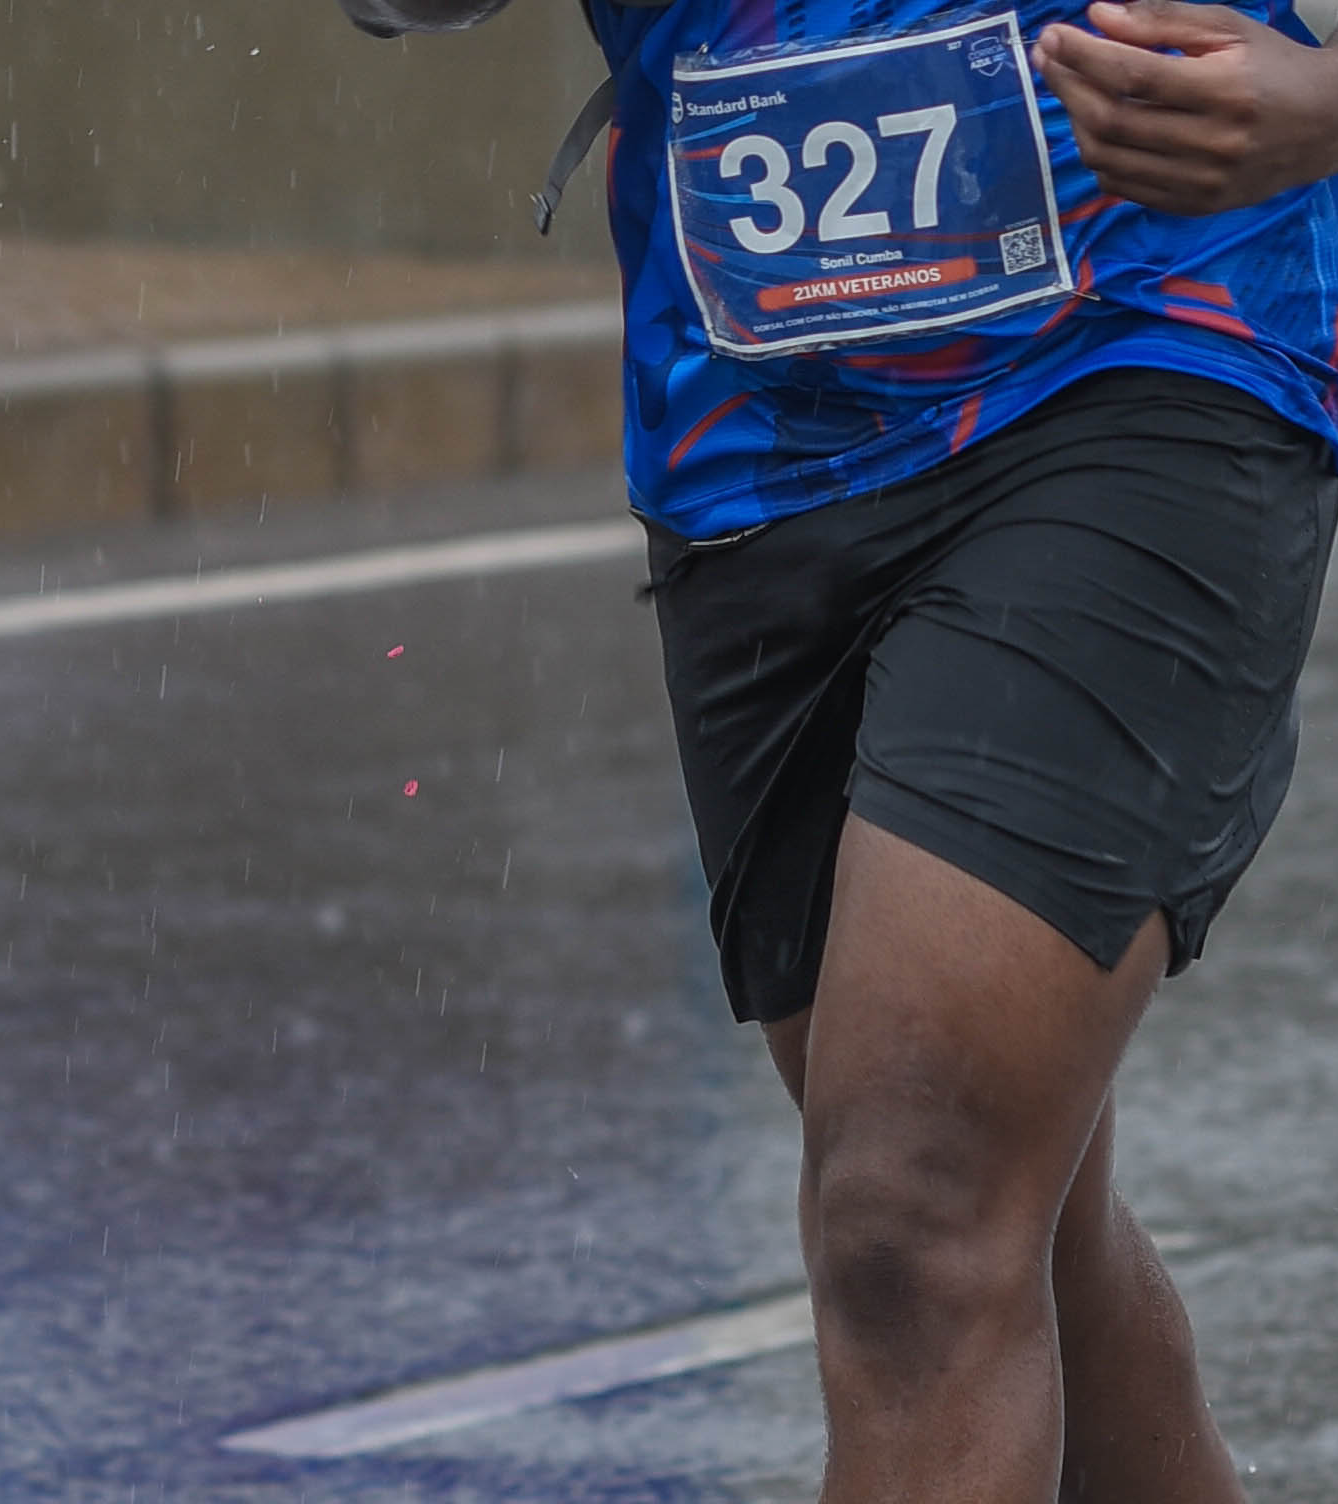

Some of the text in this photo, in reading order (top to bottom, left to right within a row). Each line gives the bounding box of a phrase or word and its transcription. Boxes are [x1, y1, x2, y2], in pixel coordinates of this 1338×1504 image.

[686, 90, 787, 116] Standard Bank
[719, 103, 958, 254] 327
[856, 249, 903, 266] Cumba
[793, 268, 942, 301] 21KM VETERANOS
